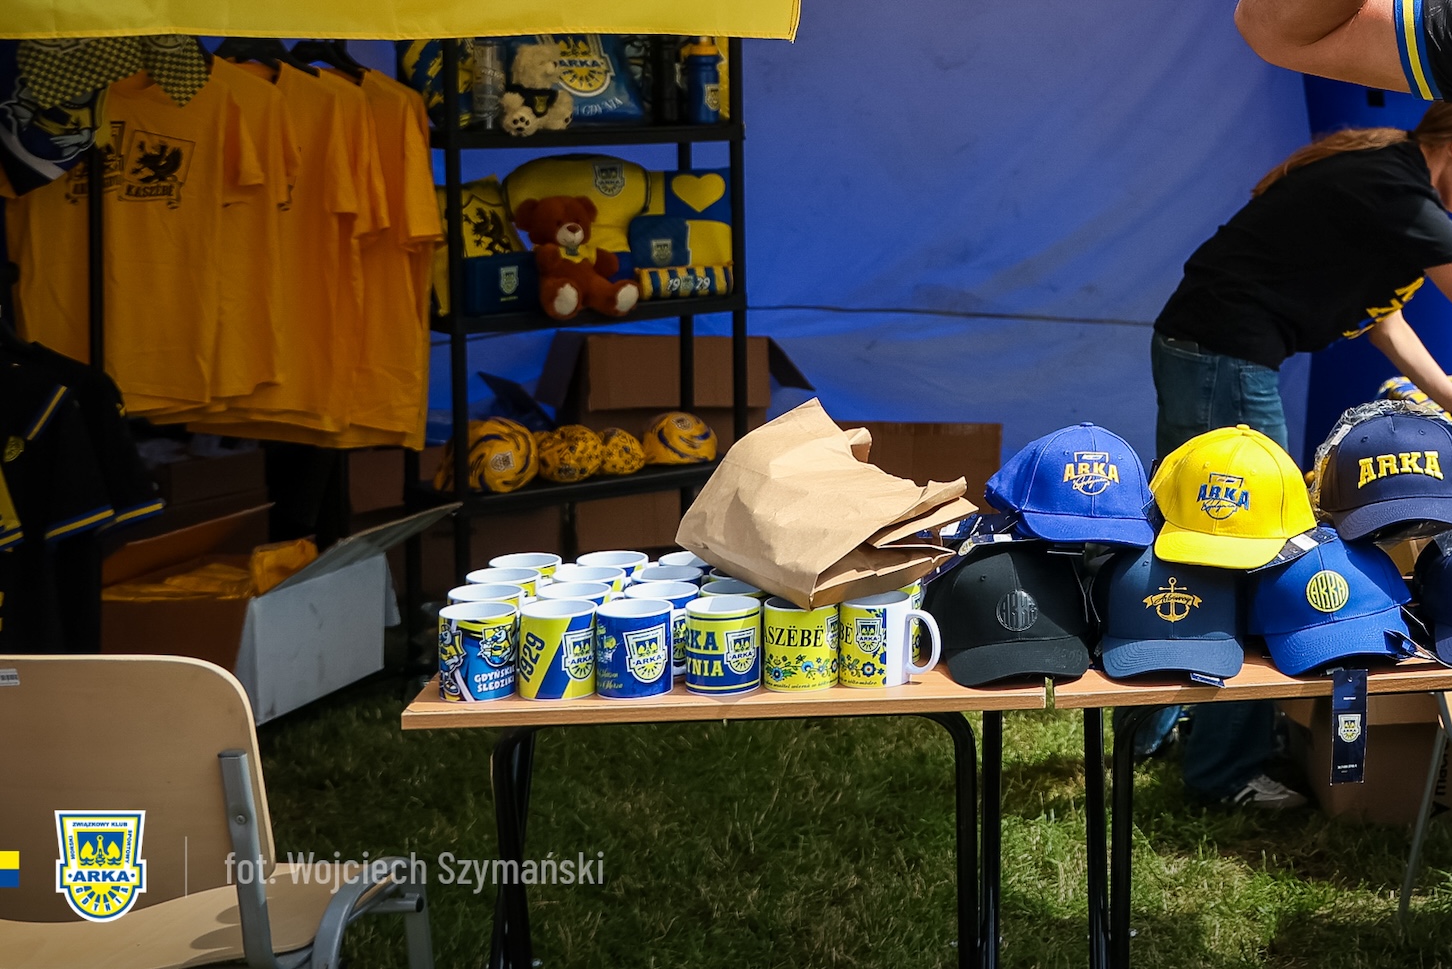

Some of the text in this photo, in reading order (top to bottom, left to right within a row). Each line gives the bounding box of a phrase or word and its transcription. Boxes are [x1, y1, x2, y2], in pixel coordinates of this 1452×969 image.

[1063, 462, 1120, 485] ARKA
[1357, 450, 1445, 490] ARKA
[1196, 483, 1251, 510] ARKA
[520, 632, 546, 683] 1929
[569, 655, 594, 666] ARKA
[635, 654, 663, 666] ARKA
[730, 650, 754, 660] ARKA
